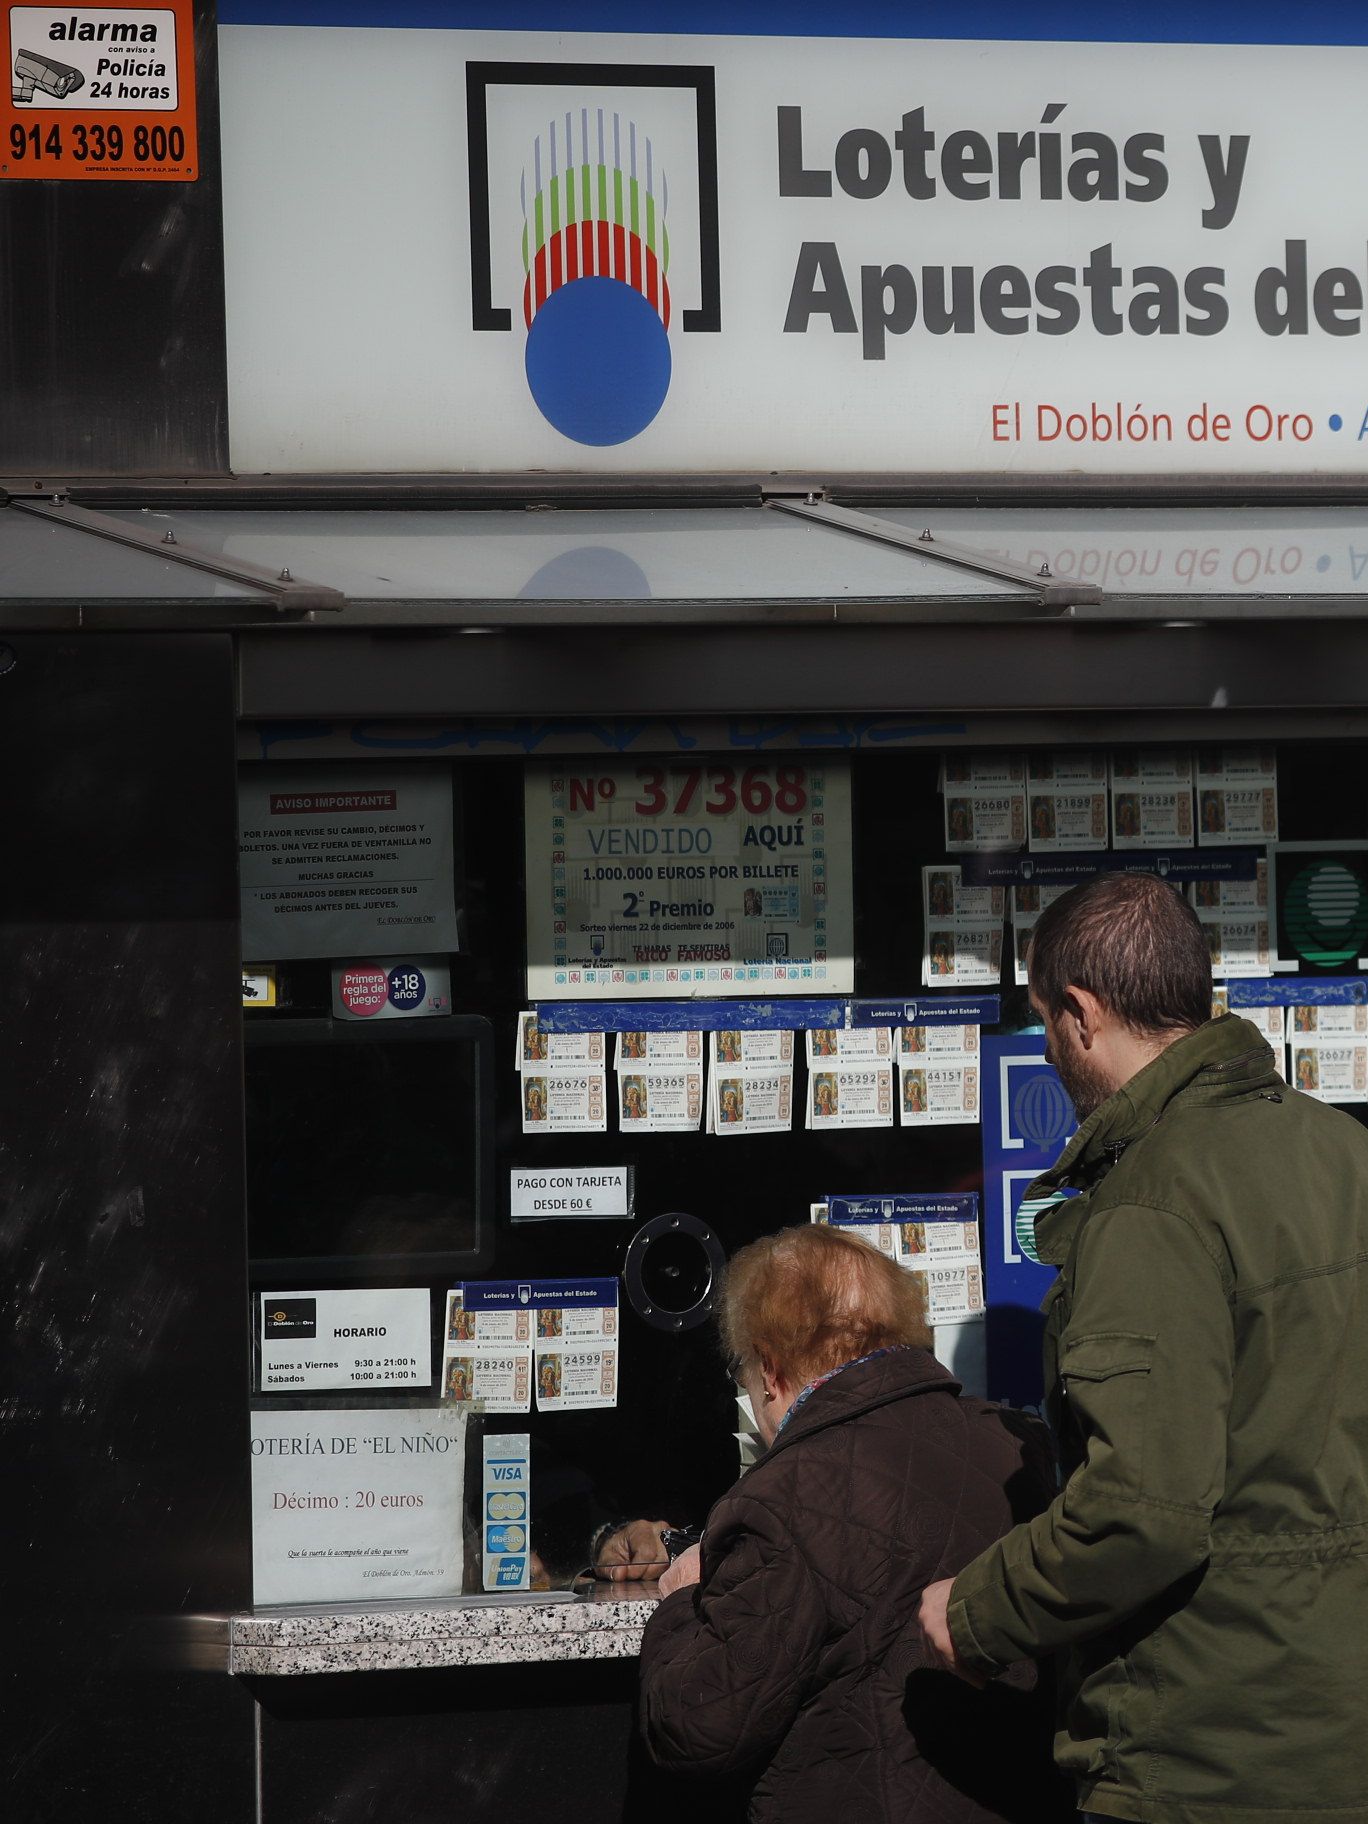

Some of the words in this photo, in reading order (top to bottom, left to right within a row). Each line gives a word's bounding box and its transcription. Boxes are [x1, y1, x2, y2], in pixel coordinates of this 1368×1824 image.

[49, 17, 158, 43] alarma
[126, 46, 148, 54] aviso
[97, 58, 166, 77] Policía
[90, 82, 112, 98] 24
[118, 83, 170, 99] horas
[10, 124, 62, 160] 914
[72, 125, 123, 161] 339
[133, 126, 185, 161] 800
[777, 104, 1168, 203] Loterías
[1198, 135, 1250, 229] y
[783, 242, 1230, 360] Apuestas
[993, 402, 1020, 441] El
[1038, 402, 1172, 442] Doblón
[1188, 403, 1231, 442] de
[1246, 405, 1313, 442] Oro
[635, 766, 807, 816] 37368
[276, 798, 311, 809] AVISO
[316, 795, 391, 807] IMPORTANTE
[264, 830, 292, 838] FAVOR
[341, 826, 377, 835] CAMBIO,
[379, 824, 416, 833] DÉCIMOS
[587, 827, 712, 854] VENDIDO
[743, 818, 804, 852] AQUÍ
[321, 841, 348, 849] FUERA
[365, 838, 417, 847] VENTANILLA
[285, 856, 323, 864] ADMITEN
[326, 853, 399, 863] RECLAMACIONES.
[337, 871, 374, 879] GRACIAS
[584, 868, 652, 880] 1.000.000
[657, 867, 705, 879] EUROS
[710, 866, 738, 878] POR
[743, 865, 799, 878] BILLETE
[649, 900, 714, 917] Premio
[663, 922, 701, 930] diciembre
[636, 951, 668, 962] RICO
[678, 951, 730, 961] FAMOSO
[345, 975, 384, 984] Primera
[392, 974, 419, 988] +18
[343, 986, 369, 996] regla
[371, 984, 386, 993] del
[394, 989, 417, 999] años
[349, 995, 380, 1006] juego:
[840, 1075, 876, 1083] 65292
[928, 1072, 962, 1080] 44151
[549, 1080, 587, 1089] 26676
[648, 1078, 684, 1088] 59365
[746, 1081, 779, 1090] 28234
[517, 1177, 546, 1188] PAGO
[550, 1176, 573, 1188] CON
[576, 1175, 622, 1187] TARJETA
[534, 1199, 567, 1210] DESDE
[570, 1199, 583, 1211] 60
[585, 1199, 592, 1210] €
[931, 1270, 965, 1282] 10977
[333, 1326, 387, 1338] HORARIO
[268, 1361, 294, 1371] Lunes
[305, 1360, 338, 1370] Viernes
[354, 1358, 373, 1367] 9:30
[384, 1357, 408, 1366] 21:00
[411, 1357, 416, 1365] h
[476, 1361, 513, 1370] 28240
[564, 1355, 600, 1365] 24599
[267, 1373, 305, 1384] Sábados
[350, 1372, 373, 1381] 10:00
[384, 1371, 408, 1380] 21:00
[411, 1371, 416, 1379] h
[251, 1432, 325, 1456] OTERÍA
[331, 1437, 357, 1454] DE
[492, 1468, 522, 1480] VISA
[273, 1492, 339, 1510] Décimo
[356, 1491, 375, 1508] 20
[381, 1493, 424, 1508] euros
[492, 1535, 521, 1543] Maestro
